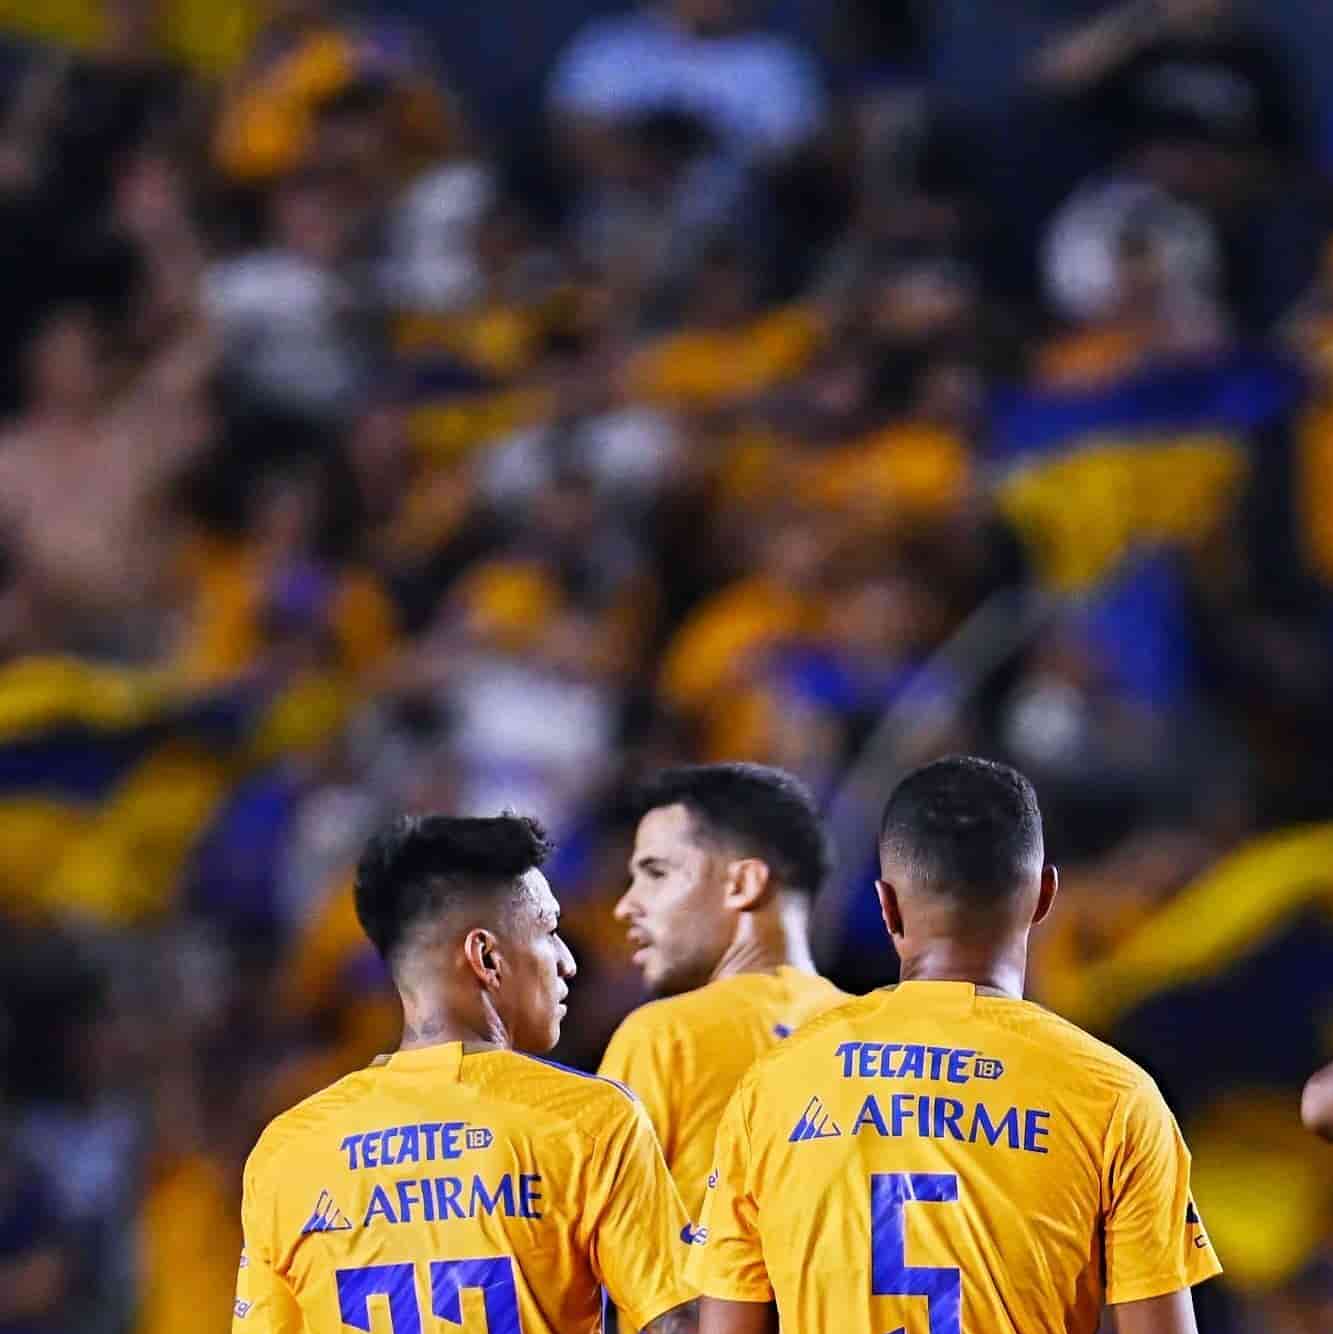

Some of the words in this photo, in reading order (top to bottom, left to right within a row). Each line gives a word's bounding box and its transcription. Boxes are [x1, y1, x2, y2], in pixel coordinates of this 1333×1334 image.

[835, 1042, 975, 1083] TECATE
[340, 1122, 464, 1170] TECATE
[852, 1095, 1050, 1154] AFIRME
[363, 1174, 542, 1227] AFIRME
